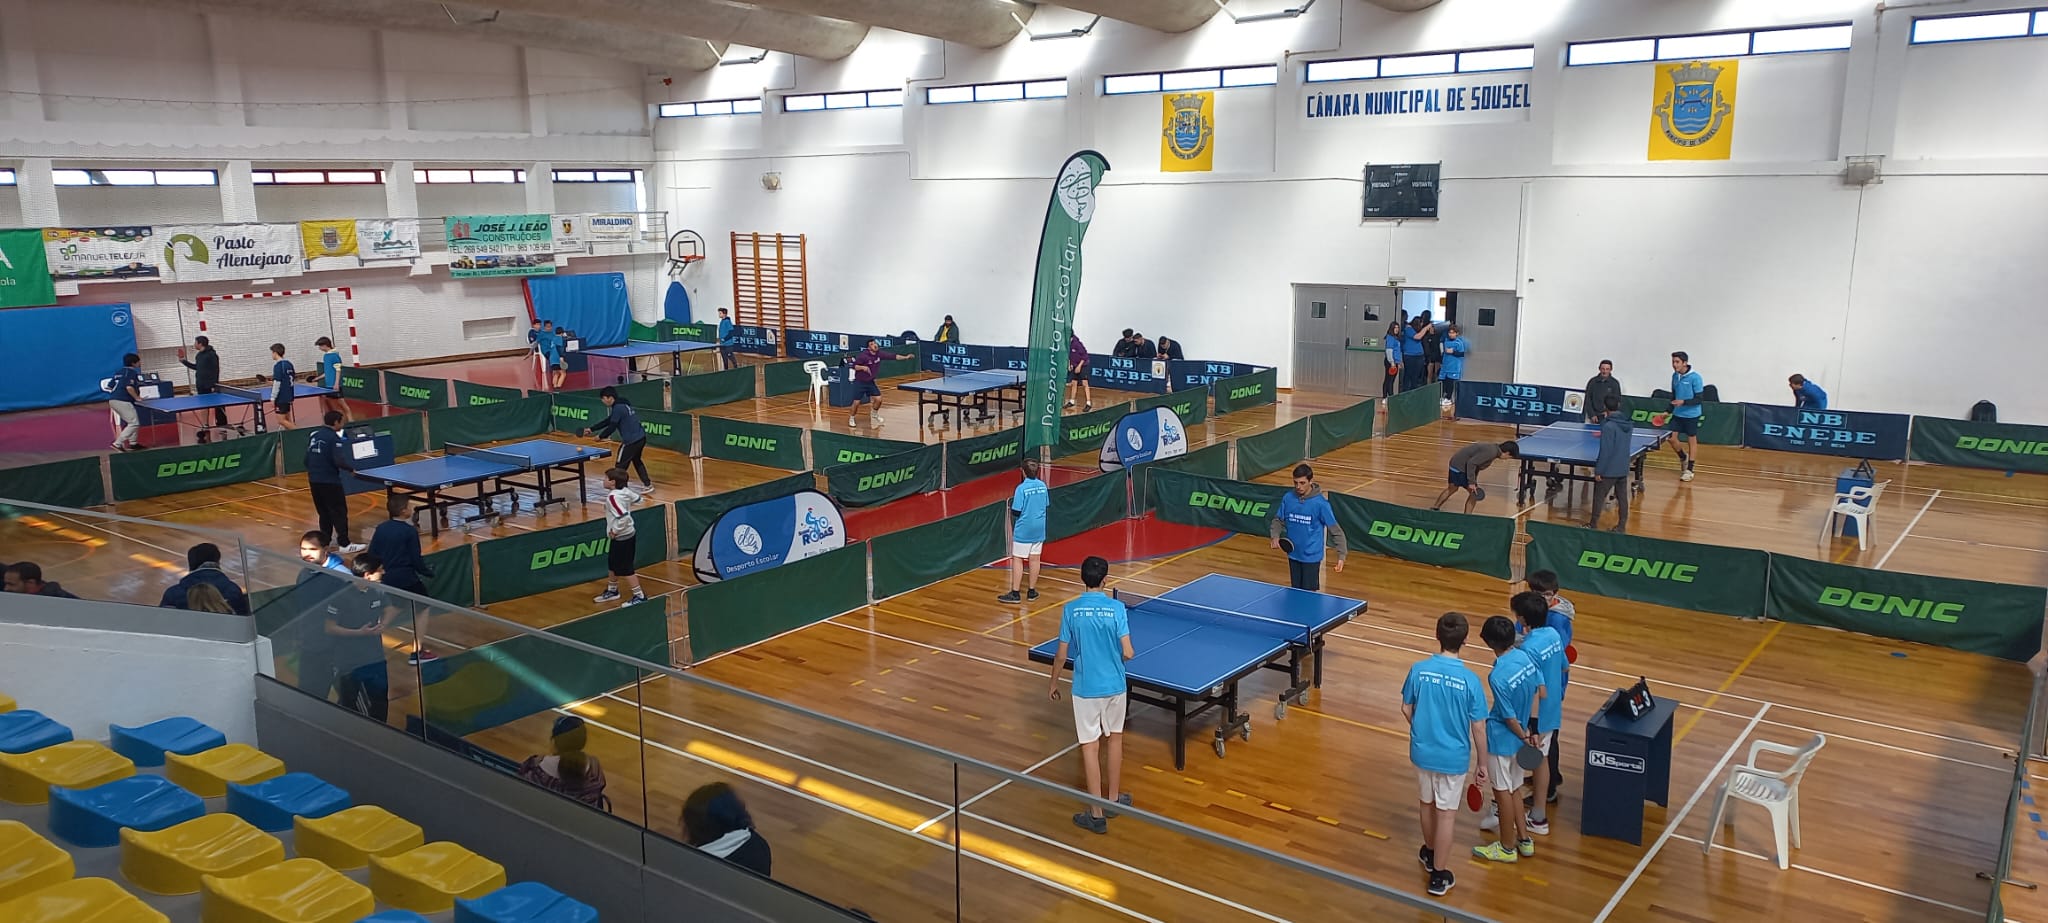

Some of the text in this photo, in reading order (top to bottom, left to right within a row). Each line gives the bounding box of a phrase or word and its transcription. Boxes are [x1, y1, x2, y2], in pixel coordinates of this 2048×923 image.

[1307, 83, 1531, 117] CÂMARA MUNICIPAL DE SOUSEL
[474, 221, 506, 232] JOSÉ
[518, 219, 548, 231] LEÃO
[592, 217, 633, 226] MIRALDINO
[213, 235, 256, 250] Pasto
[216, 252, 294, 269] Alentejano
[1052, 236, 1080, 325] Escolar
[672, 327, 702, 337] DONIC
[810, 333, 827, 341] NB
[795, 341, 841, 353] ENEBE
[948, 345, 966, 355] NB
[931, 354, 981, 367] ENEBE
[1111, 357, 1134, 369] NB
[1205, 364, 1231, 374] NB
[1041, 330, 1062, 427] Desporto
[1091, 368, 1153, 382] ENEBE
[400, 385, 431, 400] DONIC
[1229, 383, 1262, 400] DONIC
[1504, 385, 1538, 398] NB
[1476, 395, 1562, 415] ENEBE
[1800, 411, 1842, 426] NB
[1069, 420, 1111, 441] DONIC
[1762, 423, 1877, 444] ENEBE
[724, 433, 778, 451] DONIC
[968, 441, 1019, 465] DONIC
[157, 453, 242, 478] DONIC
[857, 465, 916, 492] DONIC
[1188, 491, 1271, 518] DONIC
[1368, 520, 1465, 550] DONIC
[726, 552, 780, 574] Desporto Escolar
[1577, 550, 1699, 583] DONIC
[1817, 586, 1965, 624] DONIC
[1629, 699, 1639, 716] 6
